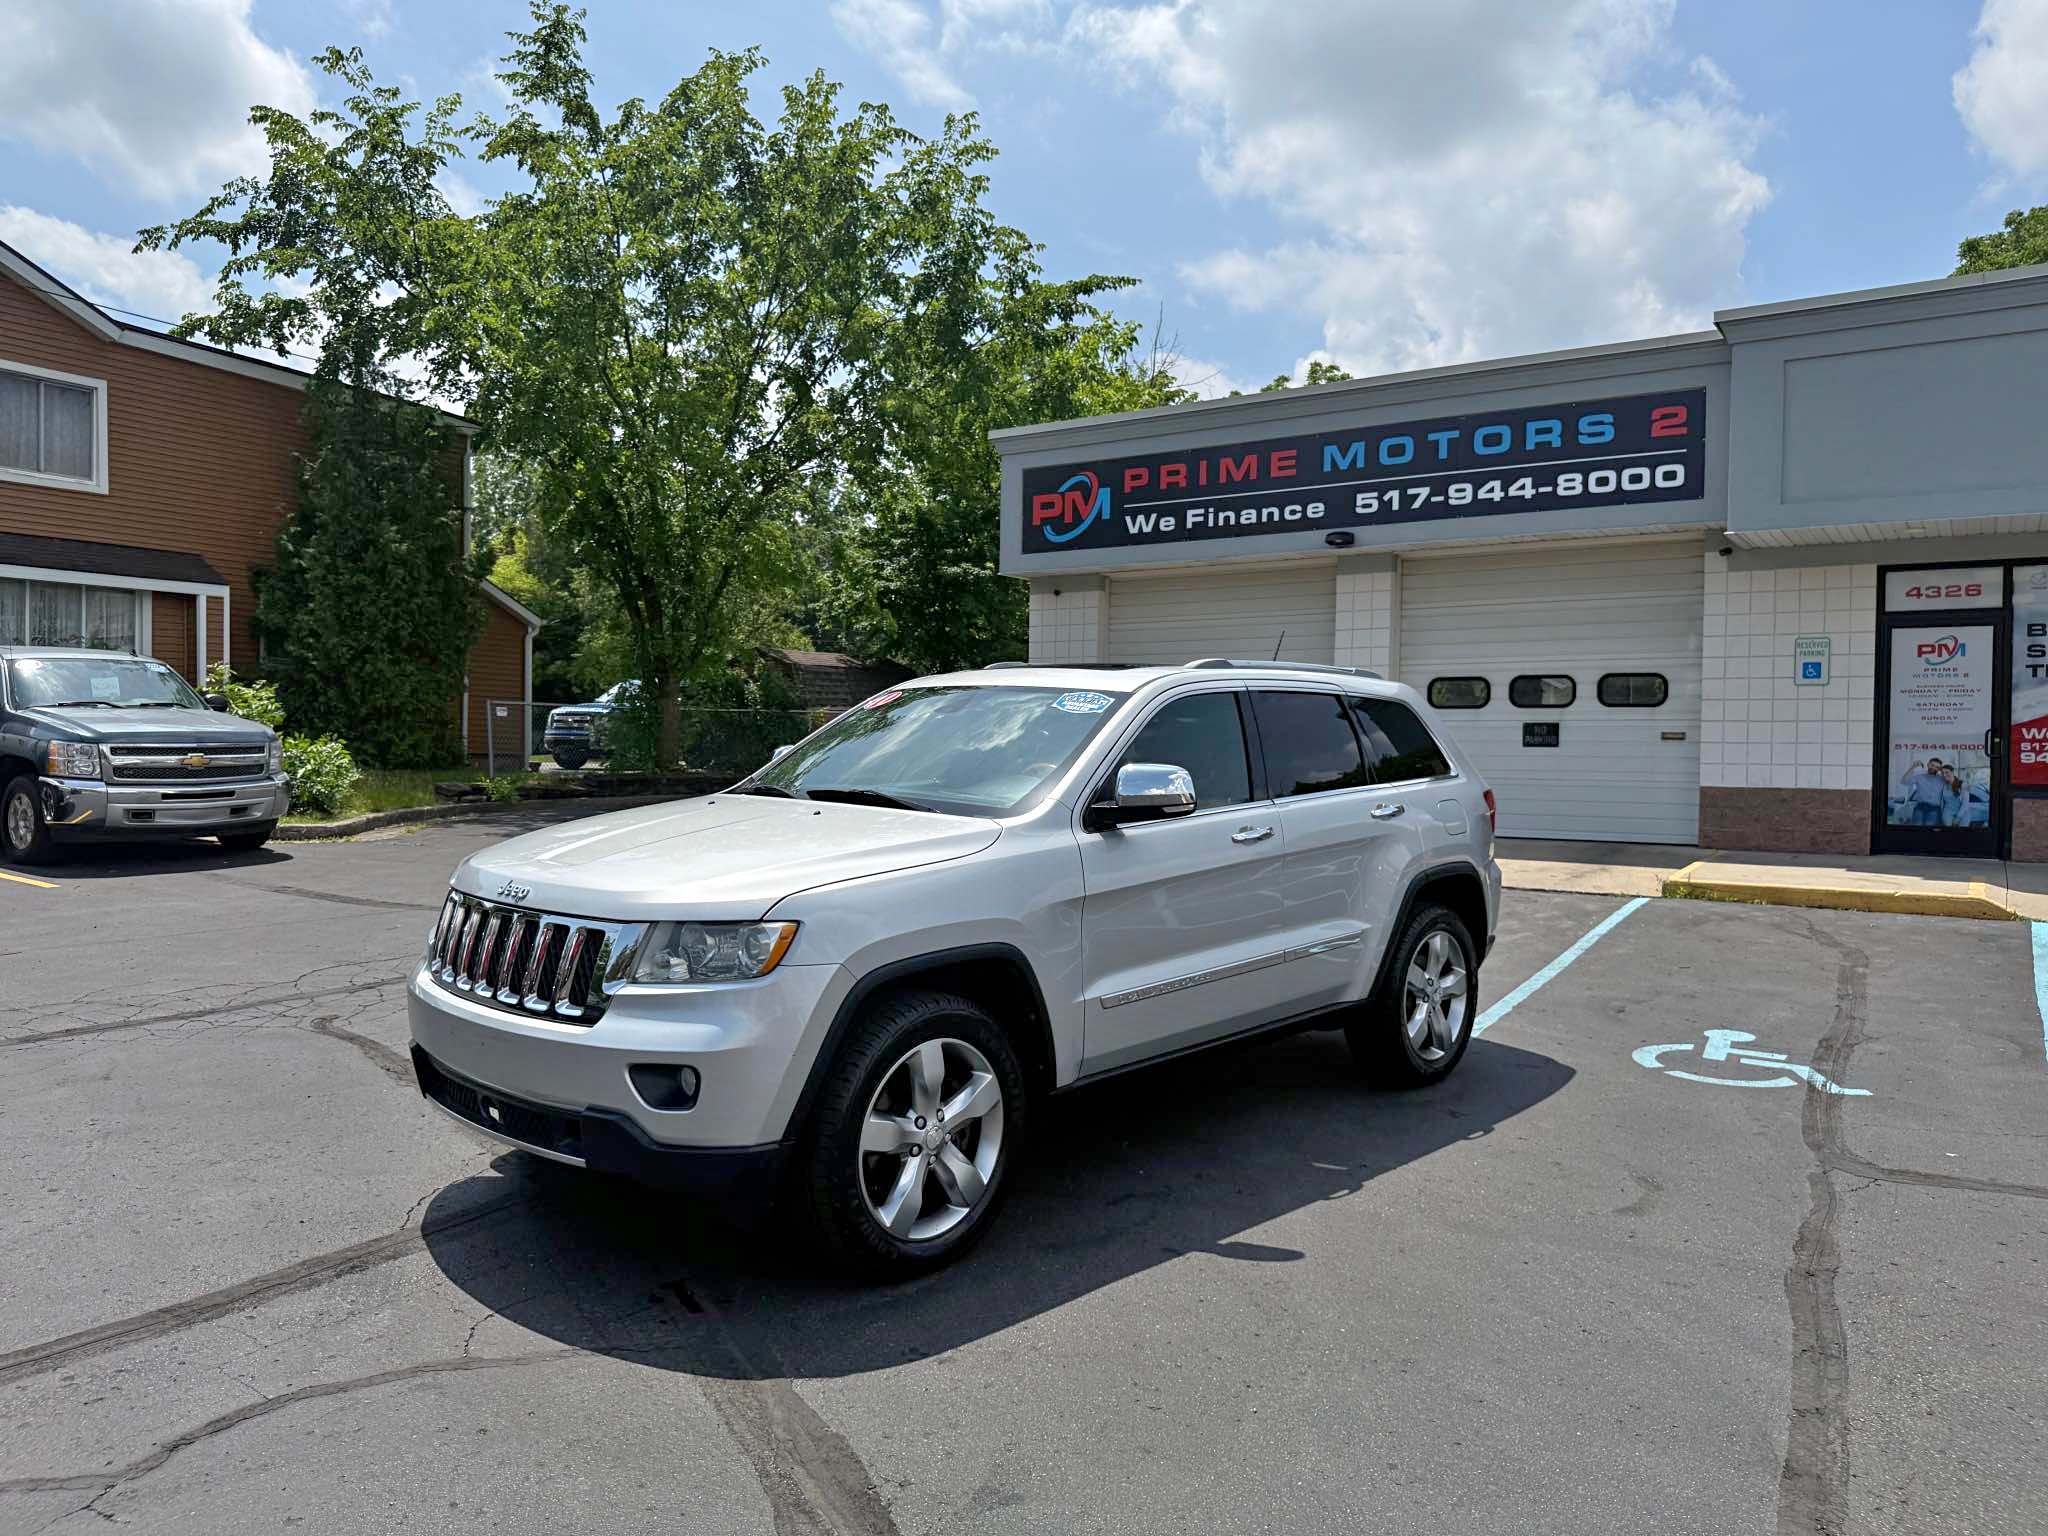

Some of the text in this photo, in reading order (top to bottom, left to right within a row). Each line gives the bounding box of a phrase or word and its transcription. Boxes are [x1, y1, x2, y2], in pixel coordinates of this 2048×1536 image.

[1123, 405, 1688, 493] PRIME MOTORS 2
[1125, 463, 1685, 534] We Finance 517-944-8000
[1904, 583, 1982, 599] 4326
[496, 880, 531, 904] Jeep
